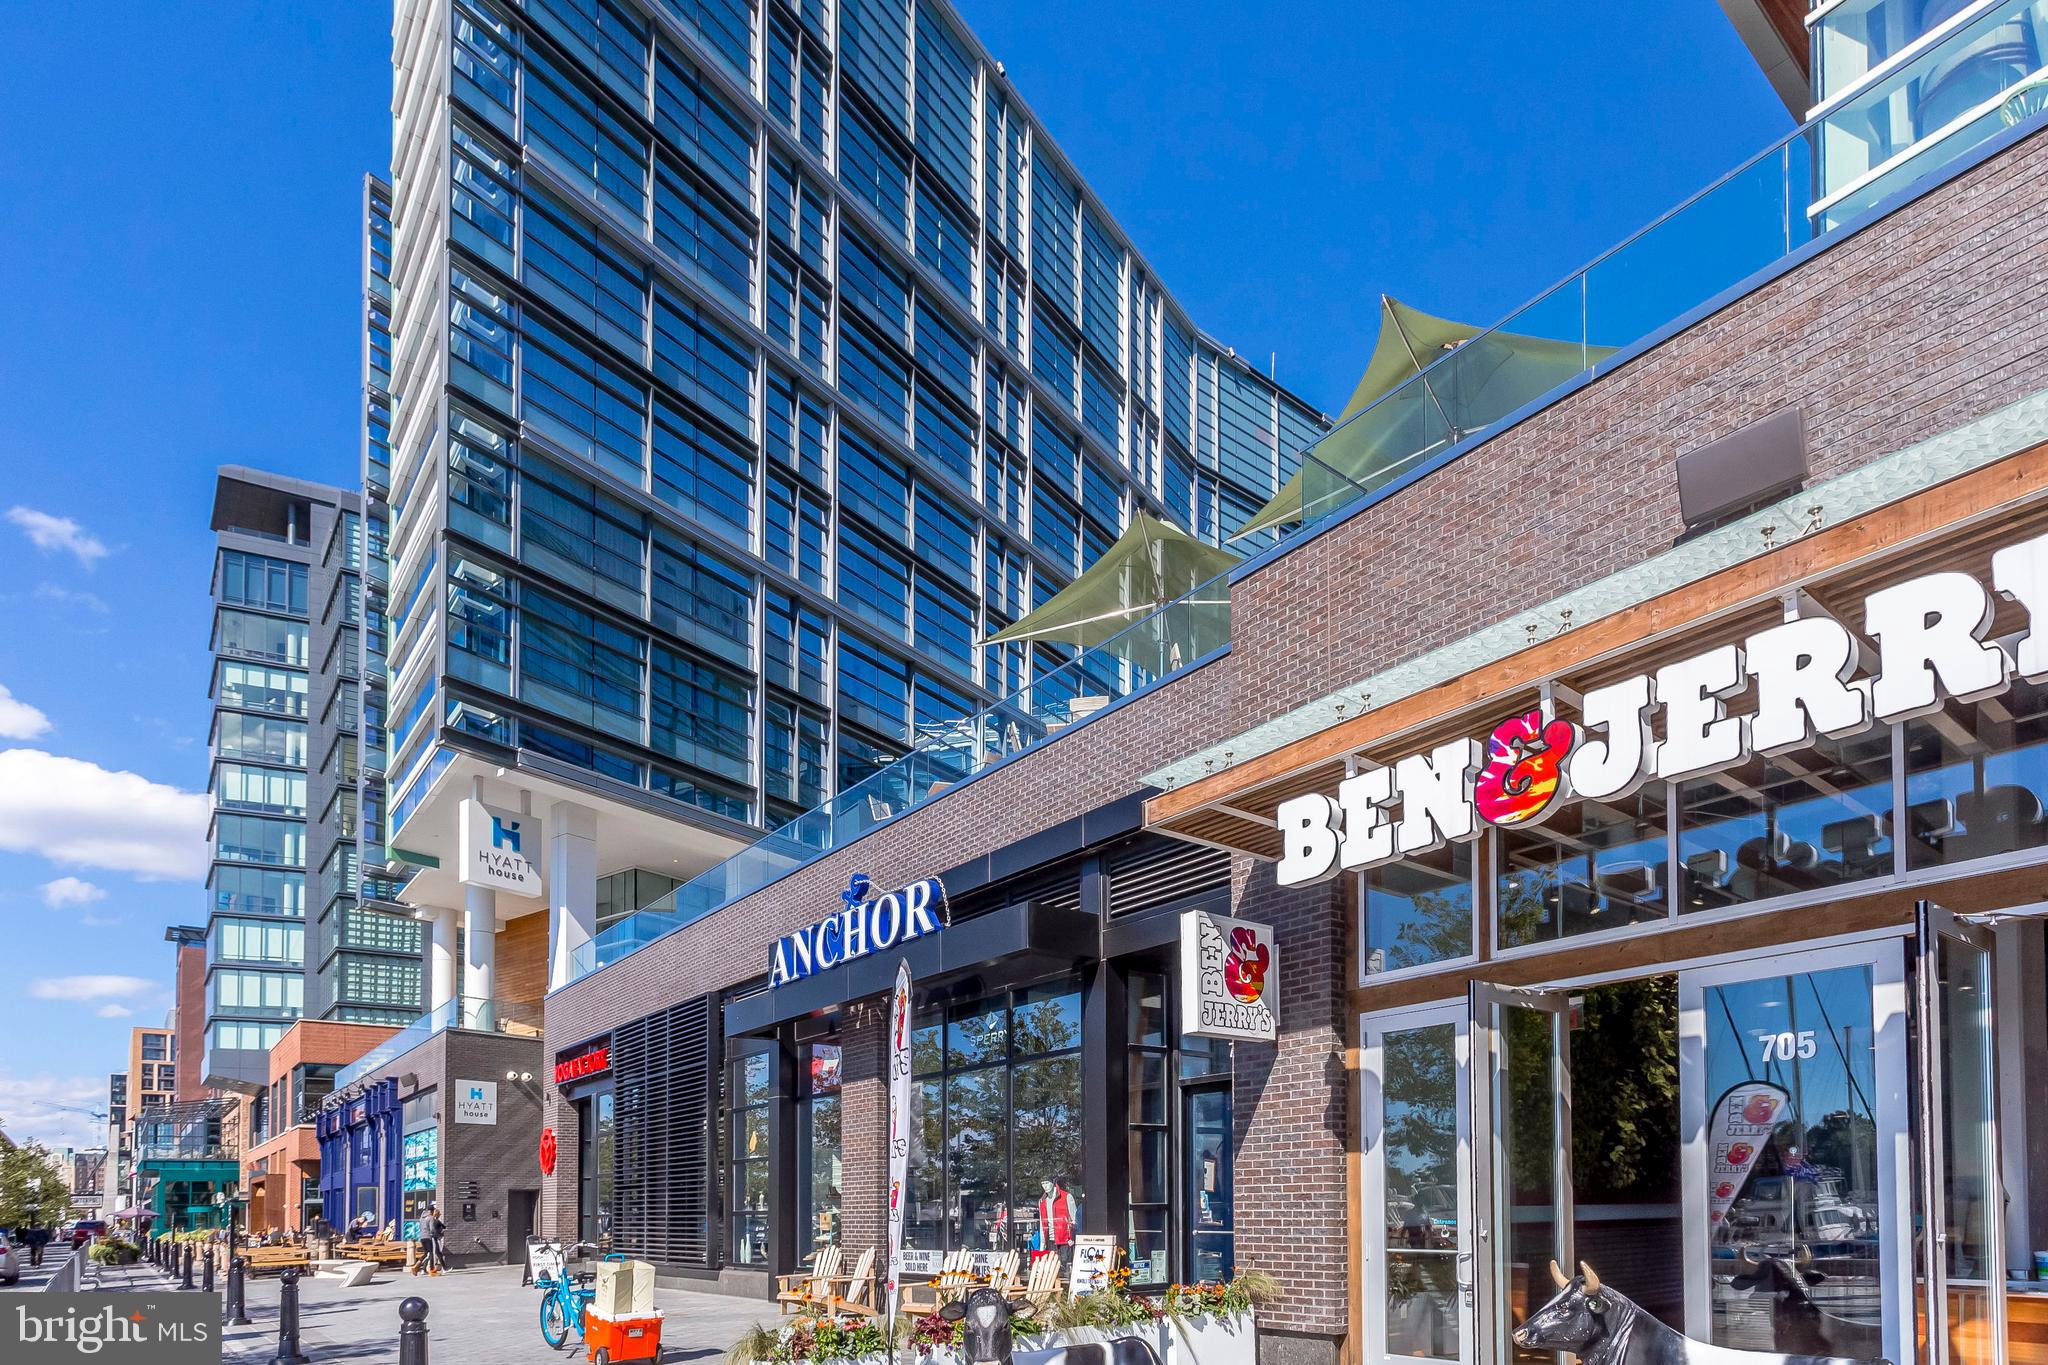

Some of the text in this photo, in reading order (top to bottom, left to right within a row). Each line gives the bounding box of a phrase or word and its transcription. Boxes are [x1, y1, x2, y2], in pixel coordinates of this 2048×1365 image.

[1276, 735, 1482, 888] BEN
[1474, 708, 1578, 830] &
[479, 850, 532, 873] HYATT
[488, 864, 524, 881] house
[768, 879, 938, 990] ANCHOR
[1199, 922, 1224, 998] BEN
[1201, 1000, 1272, 1033] JERRY'S
[1758, 1030, 1817, 1062] 705
[458, 1101, 493, 1111] HYATT
[463, 1110, 489, 1118] house
[902, 1251, 914, 1261] BEER
[914, 1252, 919, 1261] &
[919, 1252, 931, 1262] WINE
[904, 1262, 916, 1272] SOLD
[916, 1263, 928, 1273] HERE
